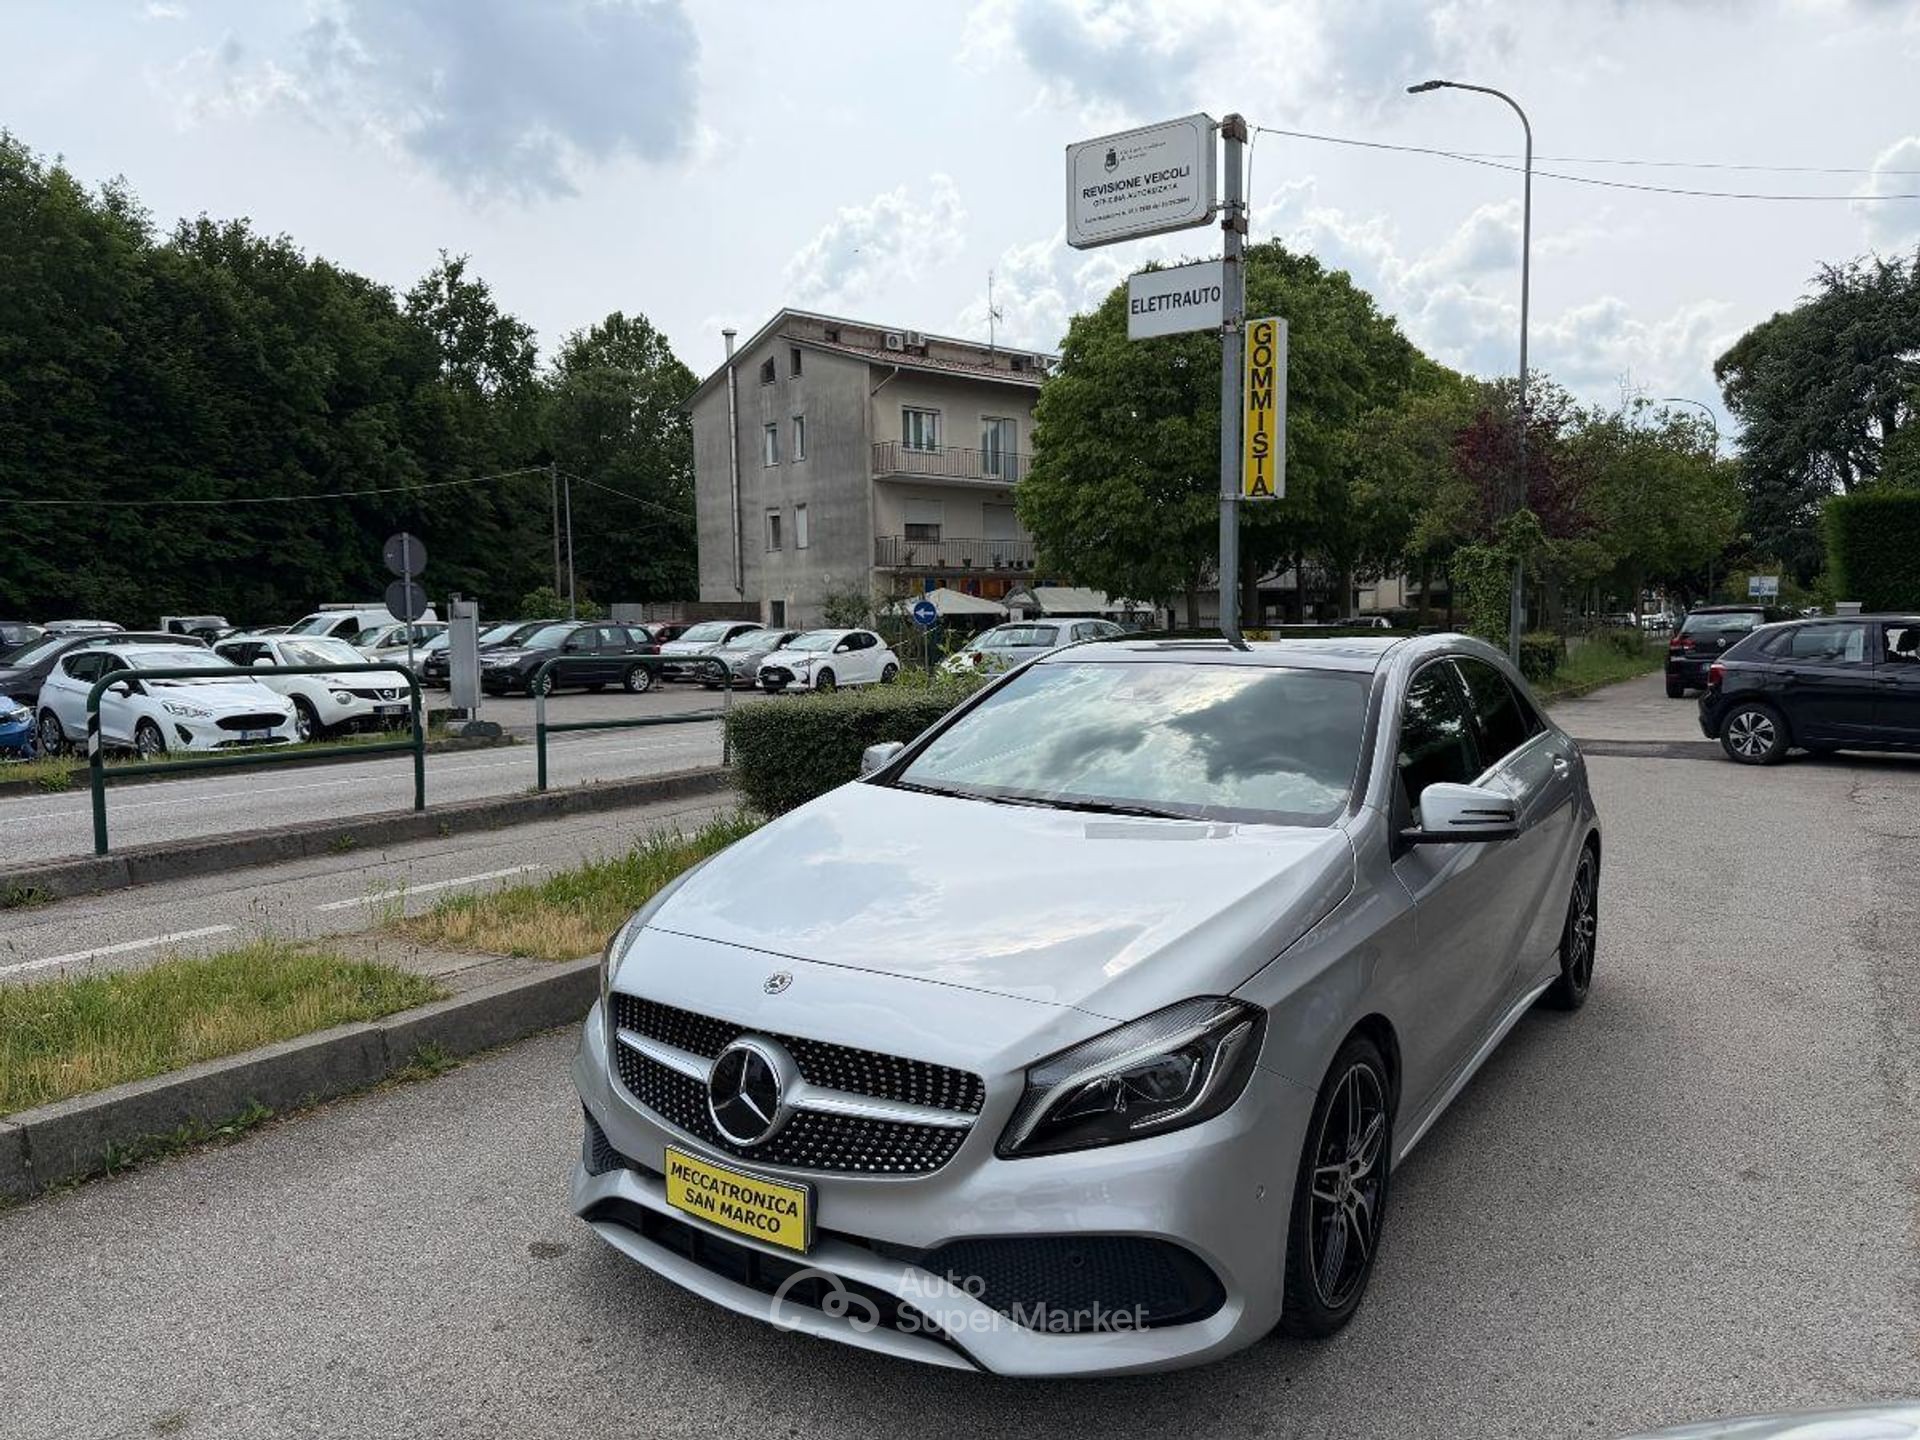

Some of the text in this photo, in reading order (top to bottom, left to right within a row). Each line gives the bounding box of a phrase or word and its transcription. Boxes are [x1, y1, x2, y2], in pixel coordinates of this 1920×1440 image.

[1083, 165, 1190, 198] REVISIONE VEICOLI
[1131, 286, 1221, 315] ELETTRAUTO
[1251, 323, 1272, 496] GOMMISTA
[671, 1162, 798, 1217] MECCATRONICA
[685, 1187, 780, 1233] SAN MARCO
